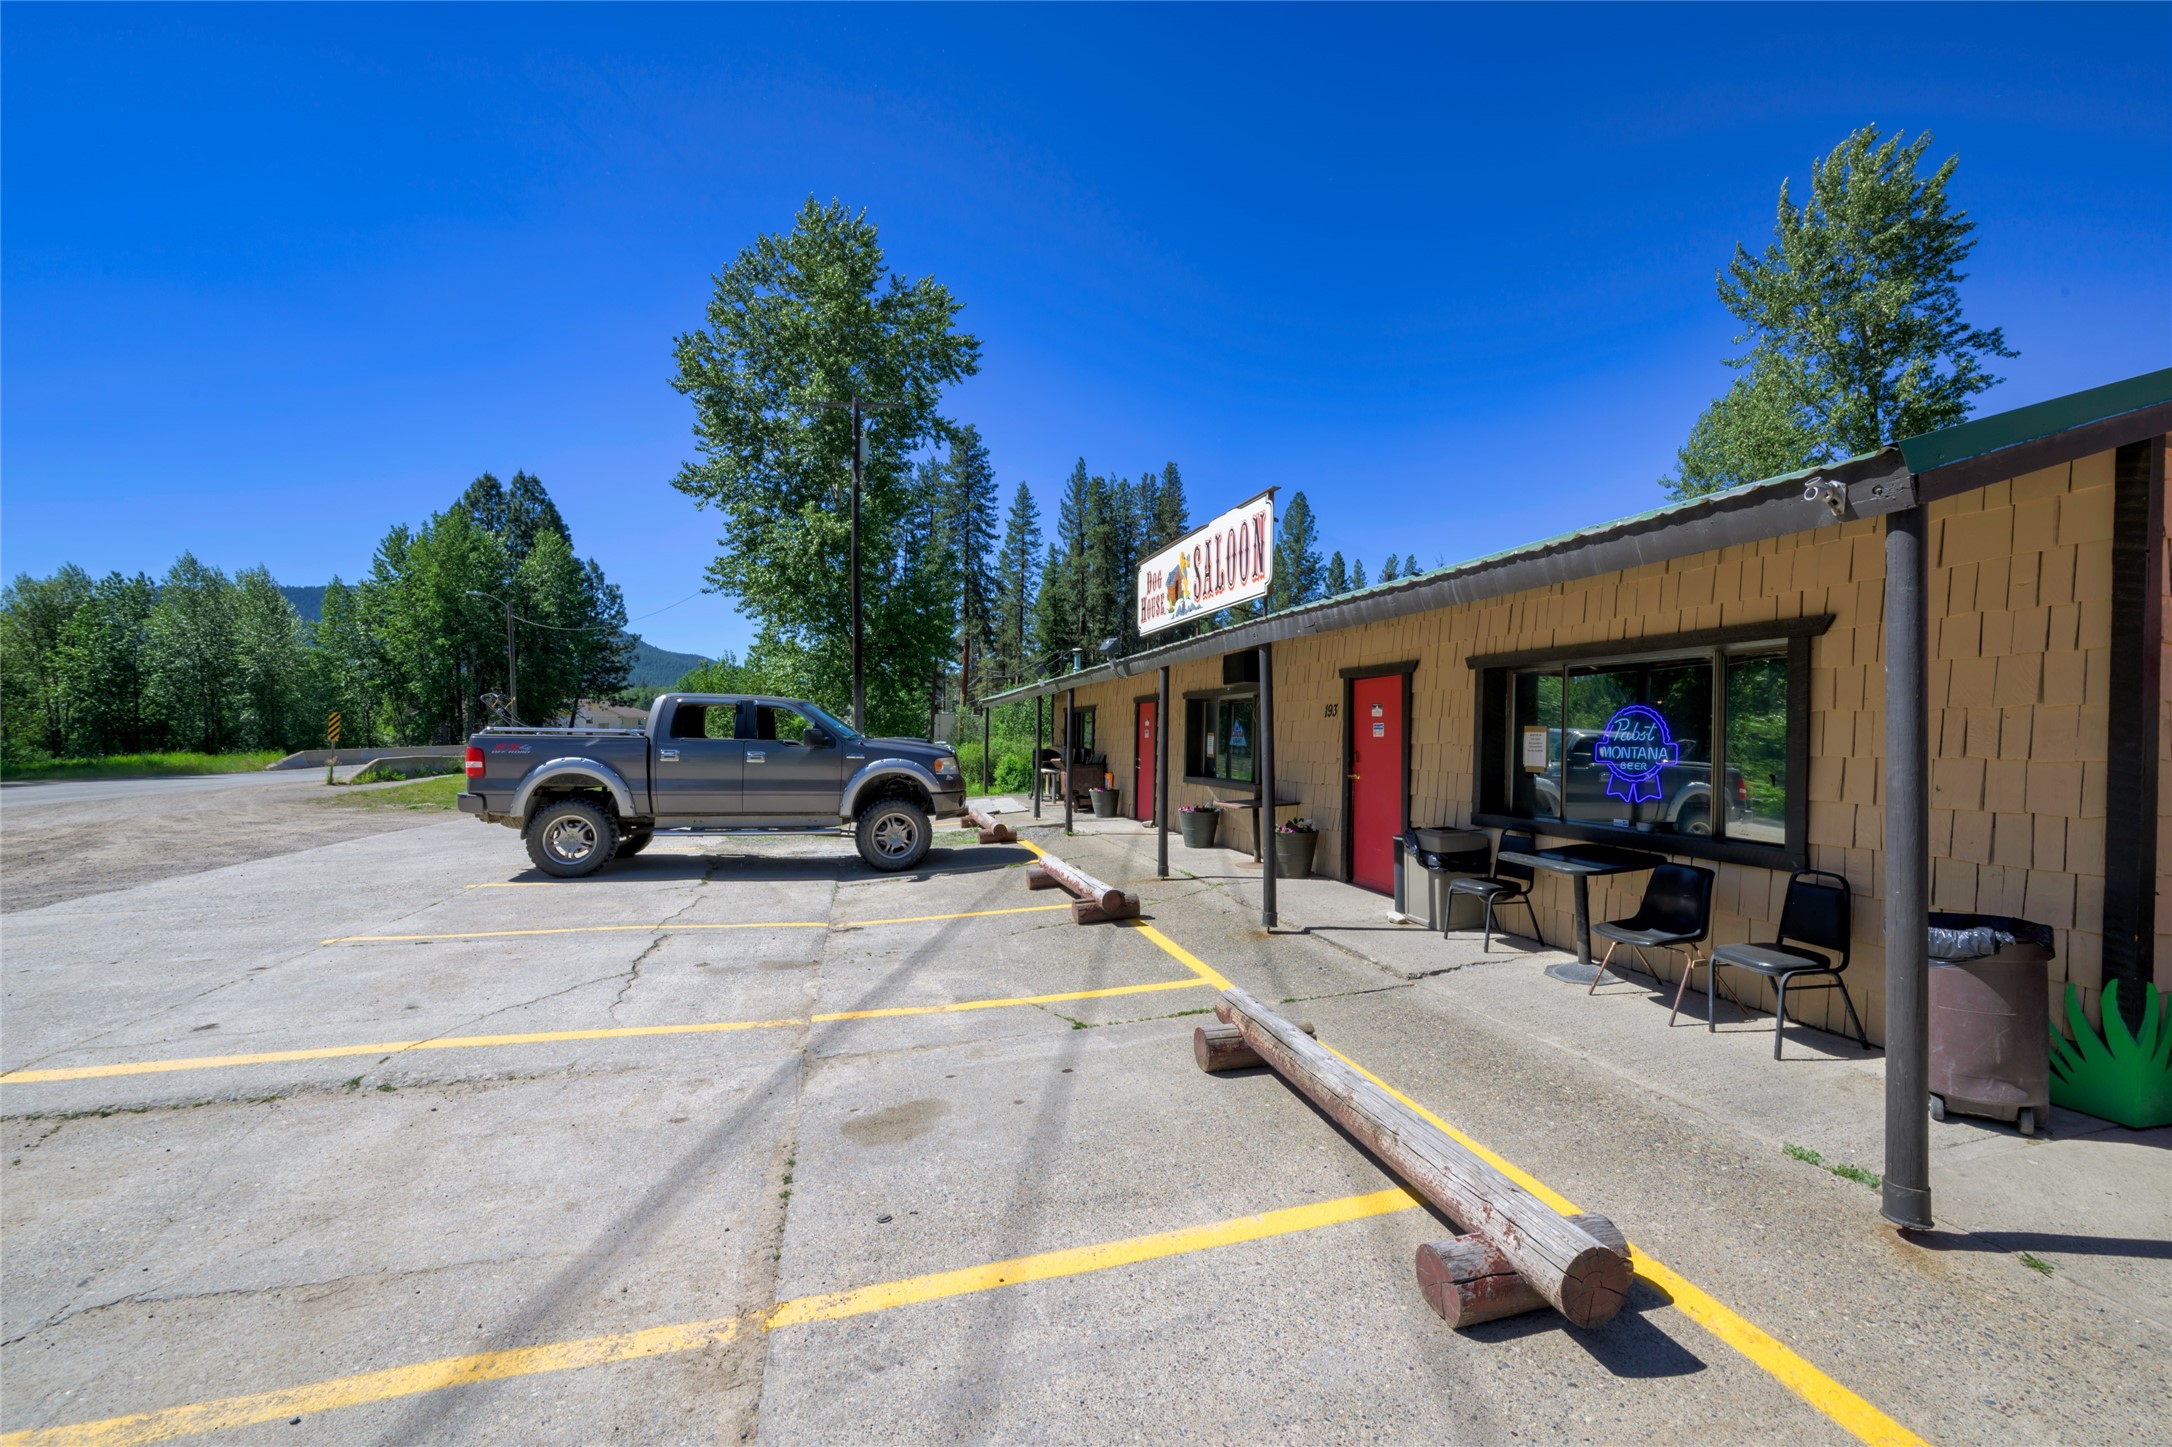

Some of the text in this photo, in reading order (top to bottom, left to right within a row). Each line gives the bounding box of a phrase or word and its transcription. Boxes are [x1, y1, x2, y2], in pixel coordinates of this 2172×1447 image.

[1193, 510, 1267, 603] SALOON
[1141, 593, 1165, 624] HOUSE
[1324, 703, 1339, 718] 193
[1614, 717, 1658, 742] Pabst
[1602, 746, 1668, 760] MONTANA
[1620, 762, 1648, 771] BEER
